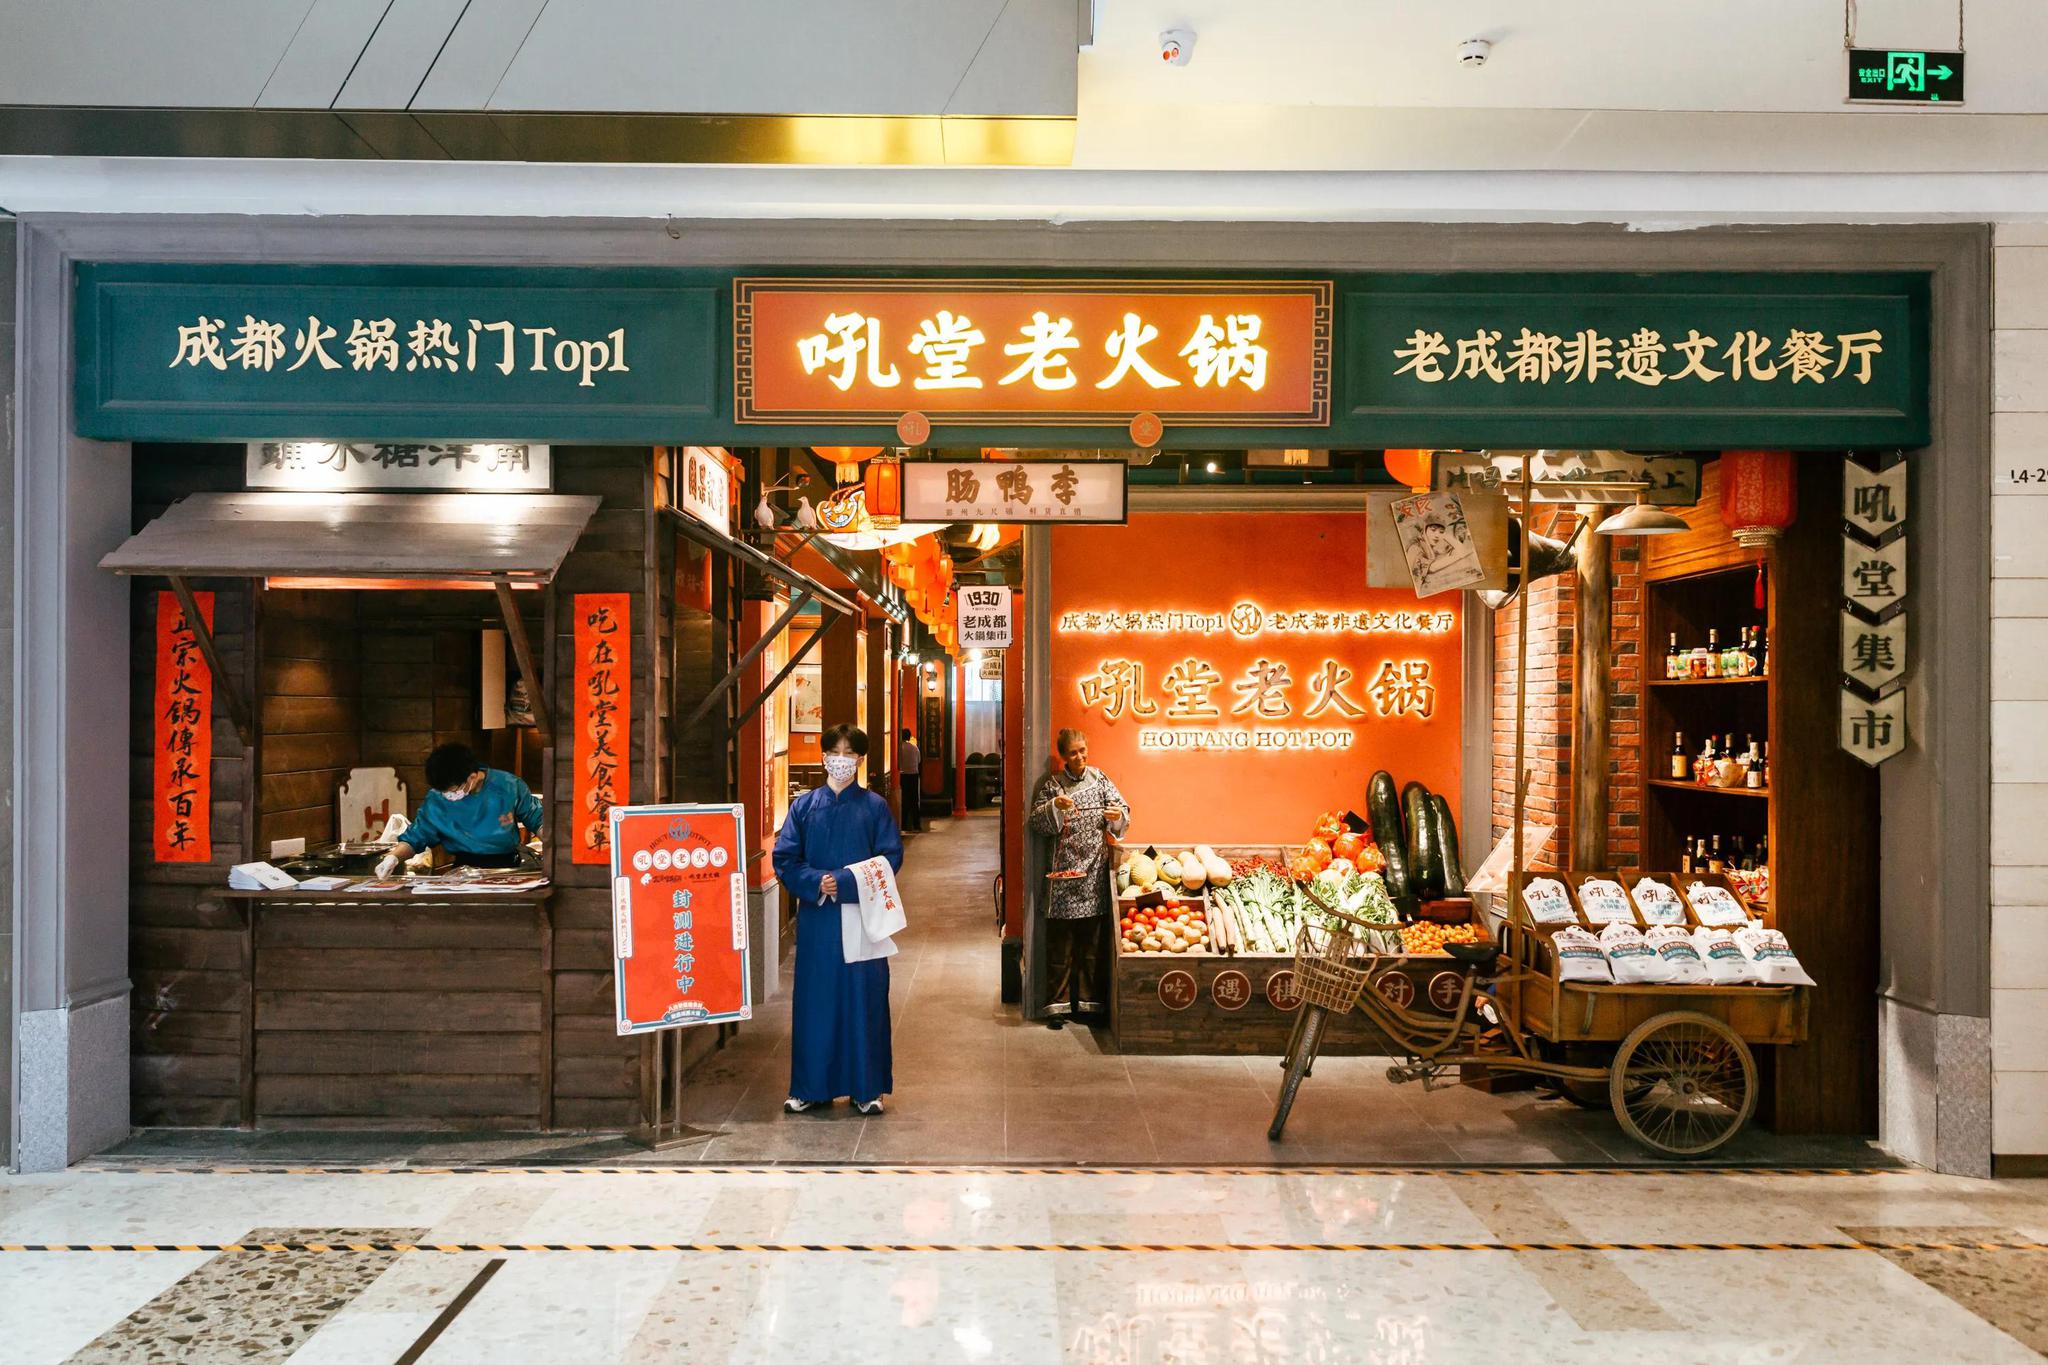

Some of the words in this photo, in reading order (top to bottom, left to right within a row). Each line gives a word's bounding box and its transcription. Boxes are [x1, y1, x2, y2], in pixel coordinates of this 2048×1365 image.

[169, 314, 630, 387] 成都火锅热门Top1
[797, 309, 1271, 393] 吼堂老火锅
[1392, 327, 1884, 387] 老成都非遗文化餐厅
[2011, 468, 2048, 484] L4-2
[967, 591, 1000, 607] 1930
[963, 614, 1007, 629] 老成都
[1060, 612, 1224, 633] 成都火锅热门Top1
[1268, 612, 1454, 632] 老成都非遗文化餐厅
[1079, 658, 1436, 719] 吼堂老火锅
[1141, 731, 1249, 748] HOUTANG
[1255, 731, 1302, 748] HOT
[1307, 731, 1352, 748] POT
[672, 888, 696, 995] 封测进行中
